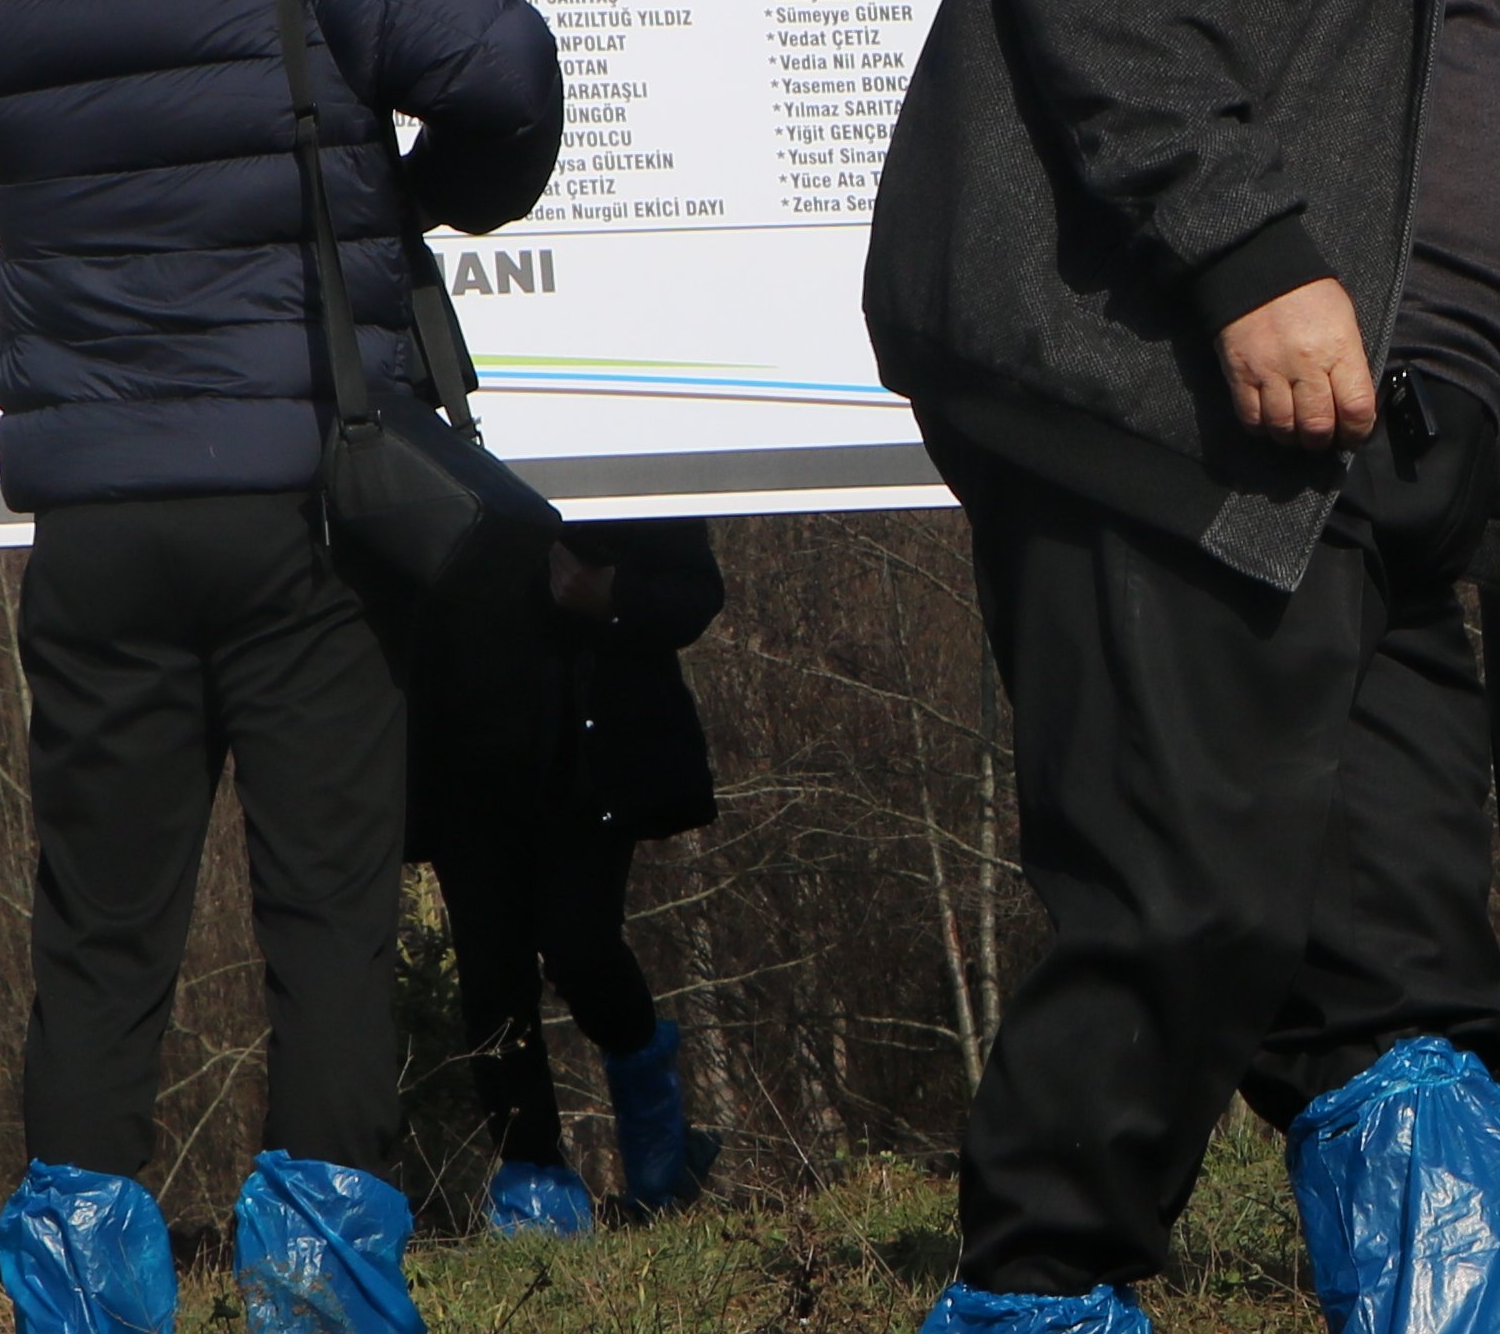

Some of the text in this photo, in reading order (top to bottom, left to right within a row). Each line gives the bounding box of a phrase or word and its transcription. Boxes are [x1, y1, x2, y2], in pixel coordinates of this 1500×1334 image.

[557, 7, 632, 28] KIZILTUĞ
[637, 10, 692, 26] YILDIZ
[776, 3, 912, 25] Sümeyye GÜNER
[557, 35, 626, 52] NPOLAT
[778, 26, 880, 49] Vedat ÇETİZ
[560, 59, 607, 75] OTAN
[780, 52, 905, 70] Vedia Nil APAK
[563, 82, 647, 103] ARATAŞLI
[782, 76, 912, 94] Yasemen BONC
[566, 104, 626, 123] ÜNGÖR
[784, 100, 902, 118] Yılmaz SARITA
[561, 130, 632, 147] UYOLCU
[786, 125, 825, 144] Yiğit
[592, 150, 673, 171] GÜLTEKİN
[788, 148, 834, 165] Yusuf
[567, 175, 615, 199] ÇETİZ
[790, 172, 831, 189] Yüce
[837, 171, 865, 187] Ata
[525, 197, 724, 222] eden Nurgül EKİCİ DAYI
[793, 196, 840, 213] Zehra
[433, 249, 556, 296] ANI
